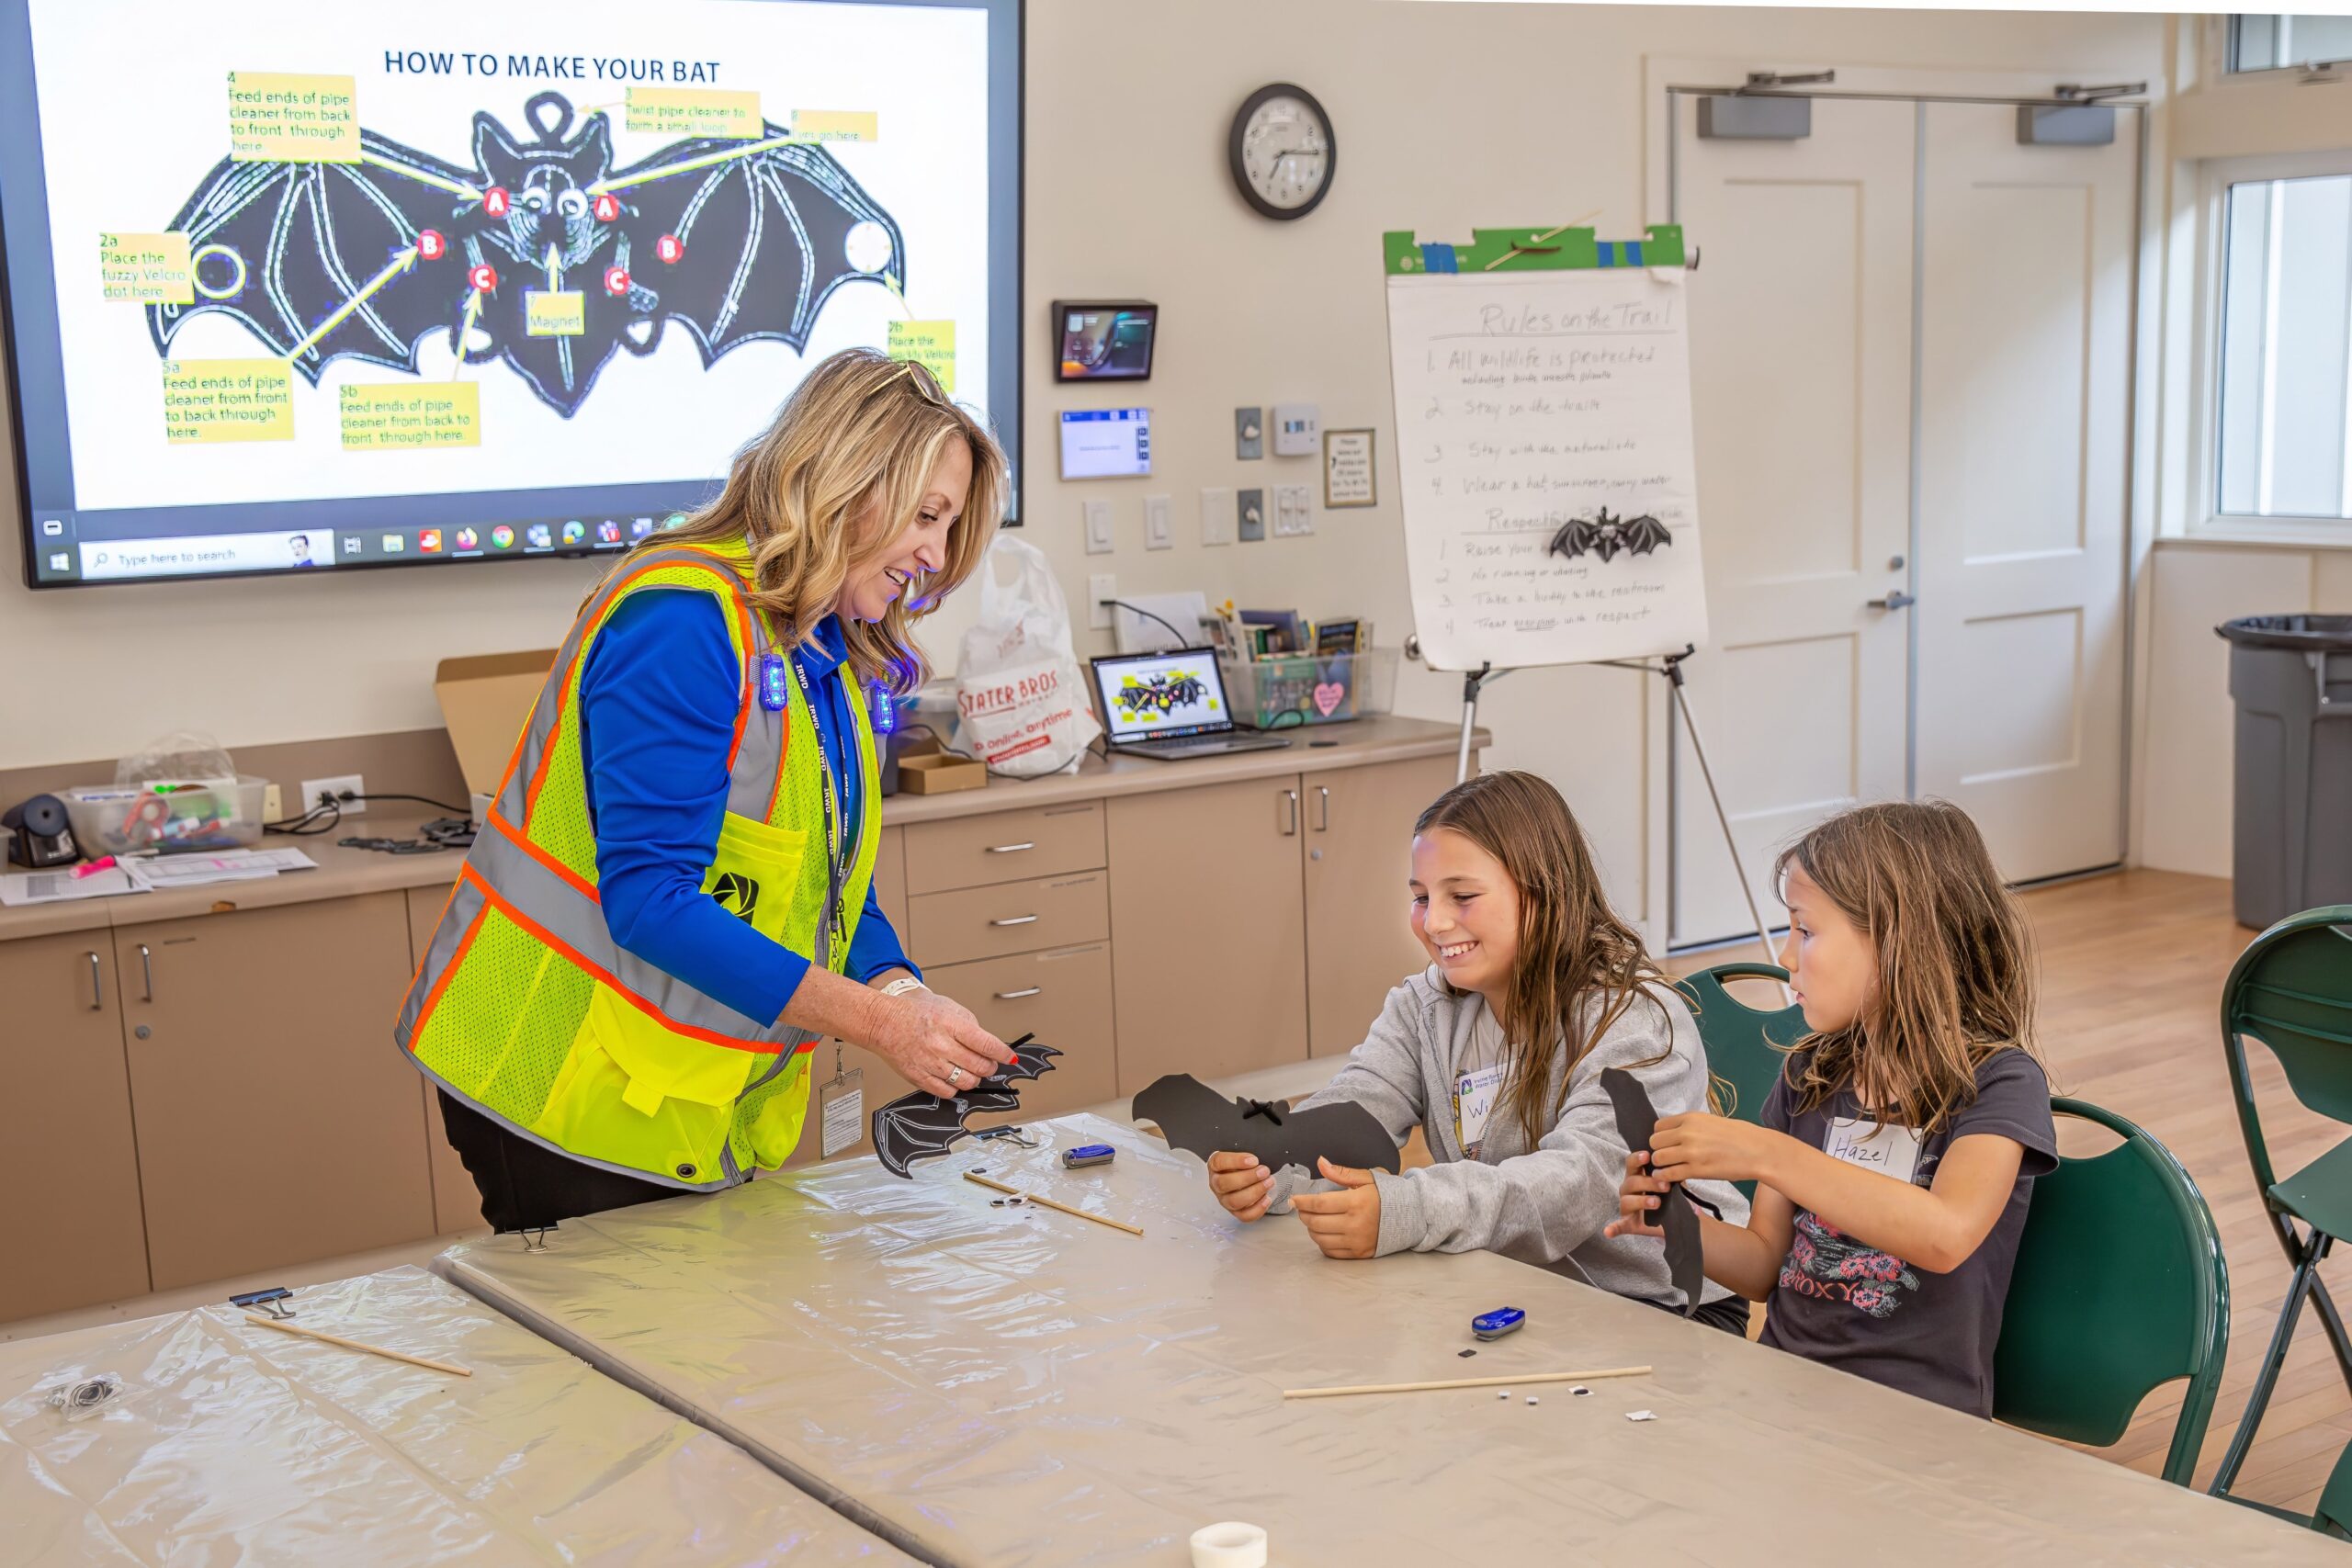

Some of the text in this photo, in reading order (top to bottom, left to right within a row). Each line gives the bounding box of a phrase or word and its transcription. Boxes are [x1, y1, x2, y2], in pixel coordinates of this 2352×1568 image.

[385, 51, 720, 83] HOW TO MAKE YOUR BAT
[227, 72, 236, 83] 4
[229, 89, 350, 107] Feed ends of pipe
[230, 106, 351, 121] cleaner from back
[230, 123, 345, 141] to front through
[488, 192, 505, 211] A
[598, 197, 614, 216] A
[100, 233, 119, 247] 2a
[422, 235, 437, 254] B
[101, 251, 165, 265] Place the
[662, 241, 676, 258] B
[102, 268, 187, 283] fuzzy Velcro
[475, 267, 491, 288] C
[609, 272, 625, 290] C
[104, 285, 128, 299] dot
[530, 314, 582, 329] Magnet
[1479, 300, 1672, 336] Rules on the Trail
[888, 335, 934, 346] Place the
[1448, 348, 1473, 370] All
[1549, 348, 1563, 367] is
[1569, 345, 1657, 372] protected
[164, 377, 286, 392] Feed ends of pipe
[340, 385, 358, 398] 5b
[165, 392, 288, 406] cleaner from front
[340, 399, 454, 413] Feed ends of pipe
[165, 408, 276, 423] to back through
[341, 414, 470, 430] cleaner from back to
[341, 433, 372, 445] front
[379, 431, 432, 446] through
[1423, 444, 1442, 464] 3
[1469, 441, 1501, 463] Stay
[1463, 475, 1507, 495] Wear
[1510, 479, 1520, 491] a
[119, 549, 236, 568] Type here to search
[796, 663, 808, 689] IRWD
[808, 704, 820, 729] IRWD
[818, 745, 827, 772] IRWD
[1833, 1134, 1894, 1167] Hazel
